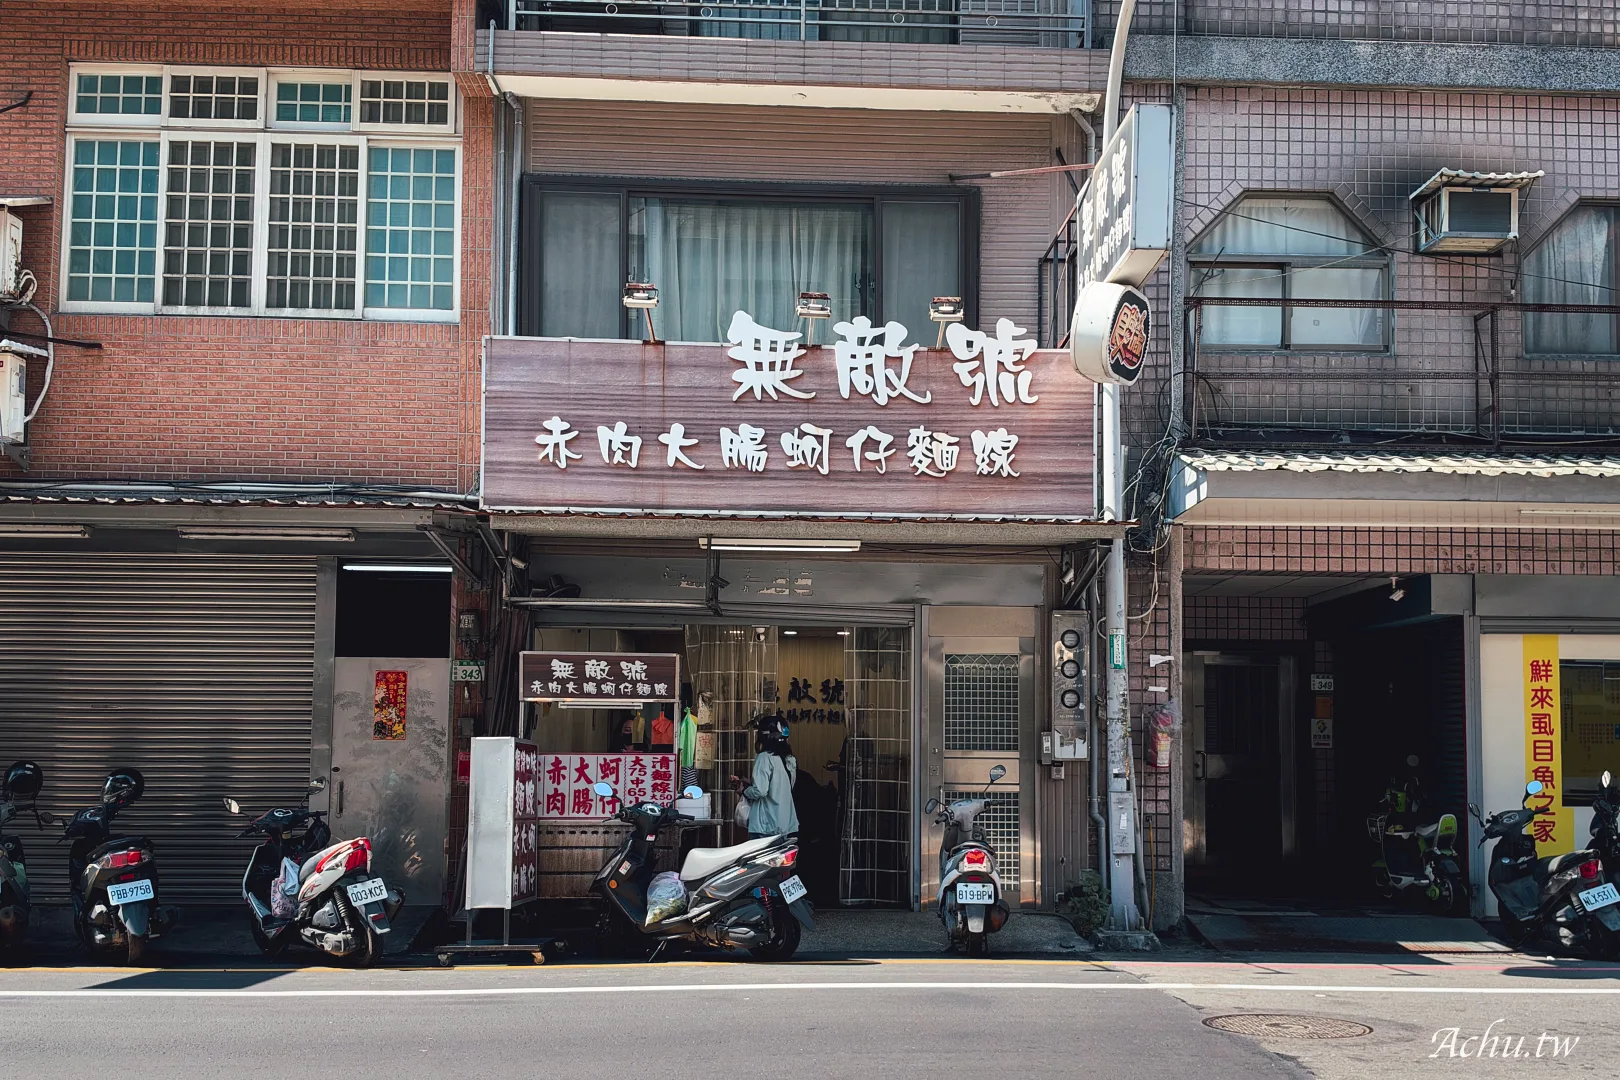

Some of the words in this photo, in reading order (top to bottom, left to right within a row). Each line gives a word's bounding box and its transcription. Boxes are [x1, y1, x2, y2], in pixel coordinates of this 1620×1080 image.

[1082, 138, 1127, 256] 無敵號
[728, 310, 1038, 406] 無敵號
[535, 415, 1021, 478] 赤肉大腸蚵仔麵線
[460, 669, 481, 680] 343
[530, 680, 669, 696] 赤肉大腸蚵仔麵線
[550, 658, 649, 681] 無敵號
[1317, 681, 1333, 690] 349
[1529, 659, 1557, 843] 鮮來虱目魚之家
[546, 756, 567, 816] 赤肉
[571, 756, 594, 816] 大腸
[599, 756, 622, 815] 蚵仔
[650, 755, 673, 793] 清麵線
[110, 884, 152, 901] PBB-9758
[350, 884, 384, 903] 003-KCF
[1582, 887, 1617, 906] NLX-5311
